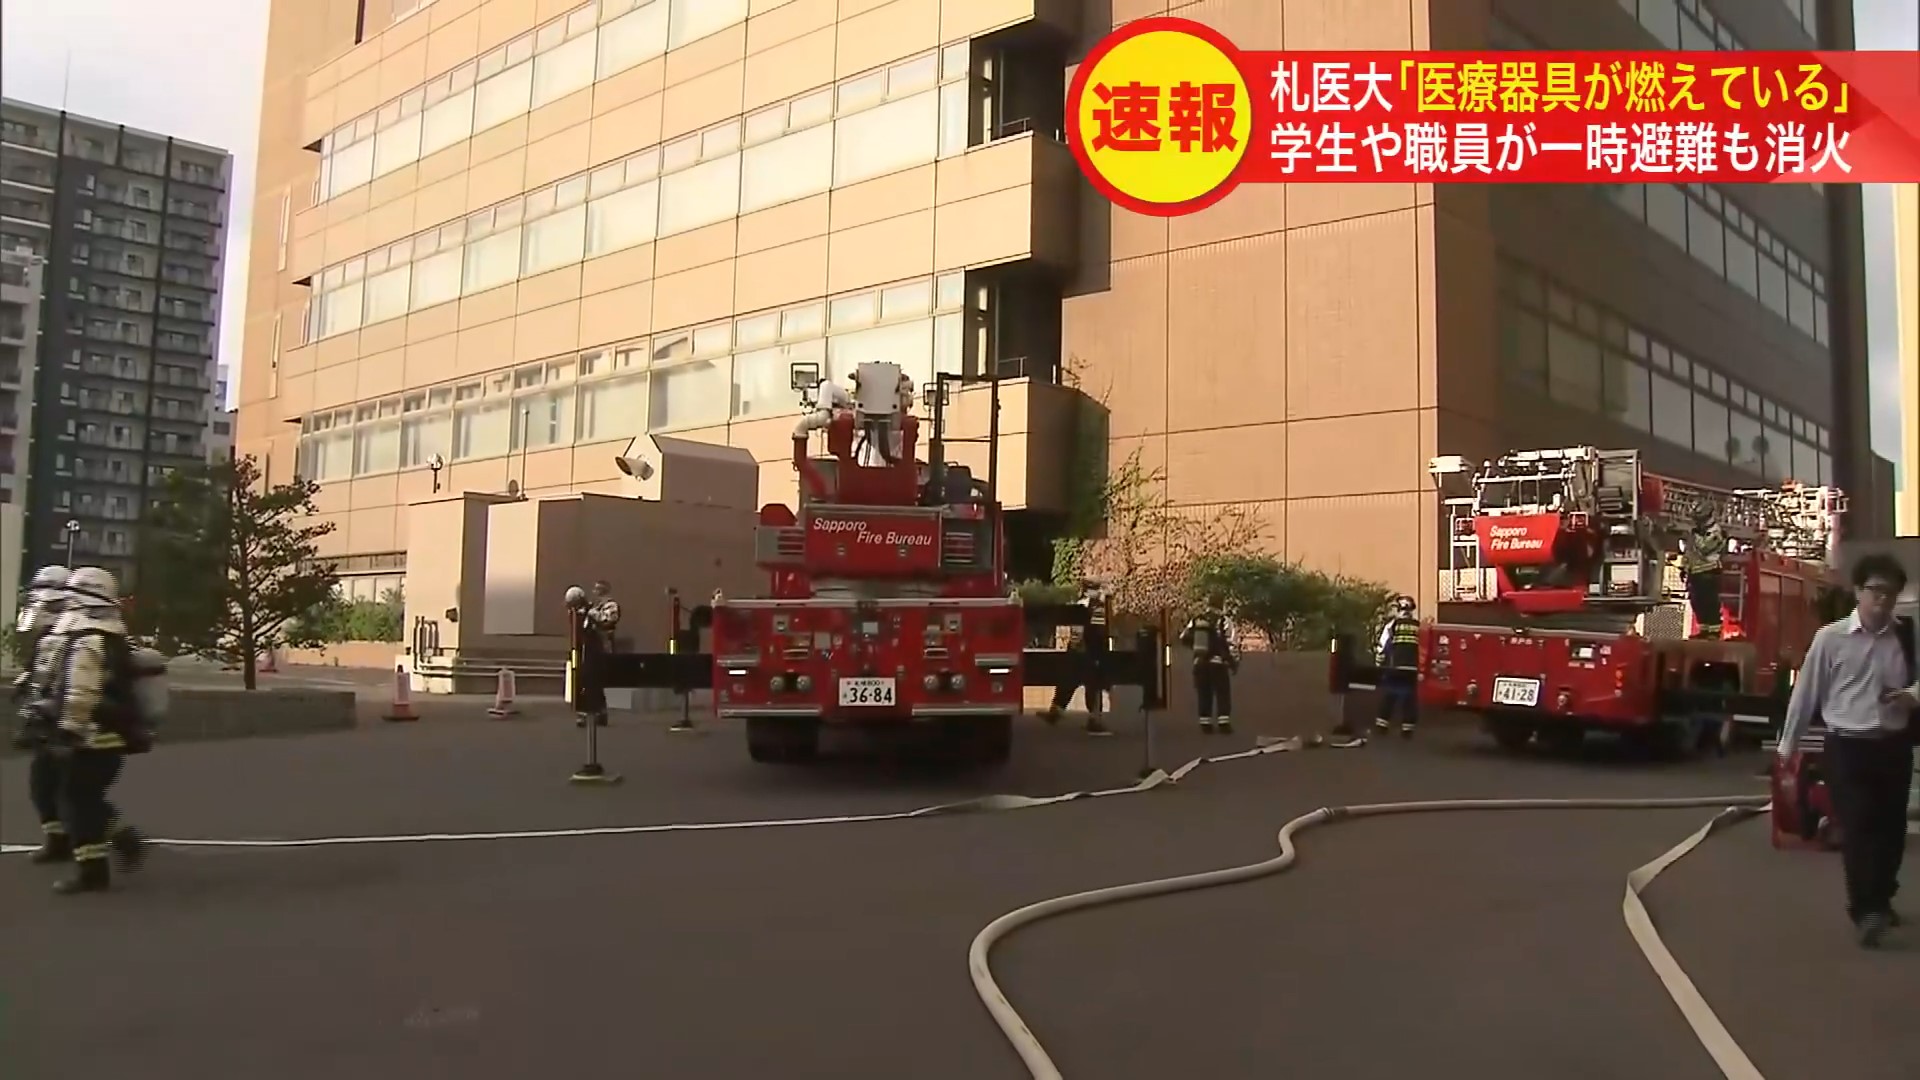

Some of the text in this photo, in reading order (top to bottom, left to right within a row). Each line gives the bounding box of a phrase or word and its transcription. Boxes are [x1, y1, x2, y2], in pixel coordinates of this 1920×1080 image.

[813, 517, 867, 533] Sapporo
[1489, 525, 1528, 538] Sapporo
[856, 531, 932, 545] Fire Bureau
[1490, 537, 1543, 550] Fire Bureau
